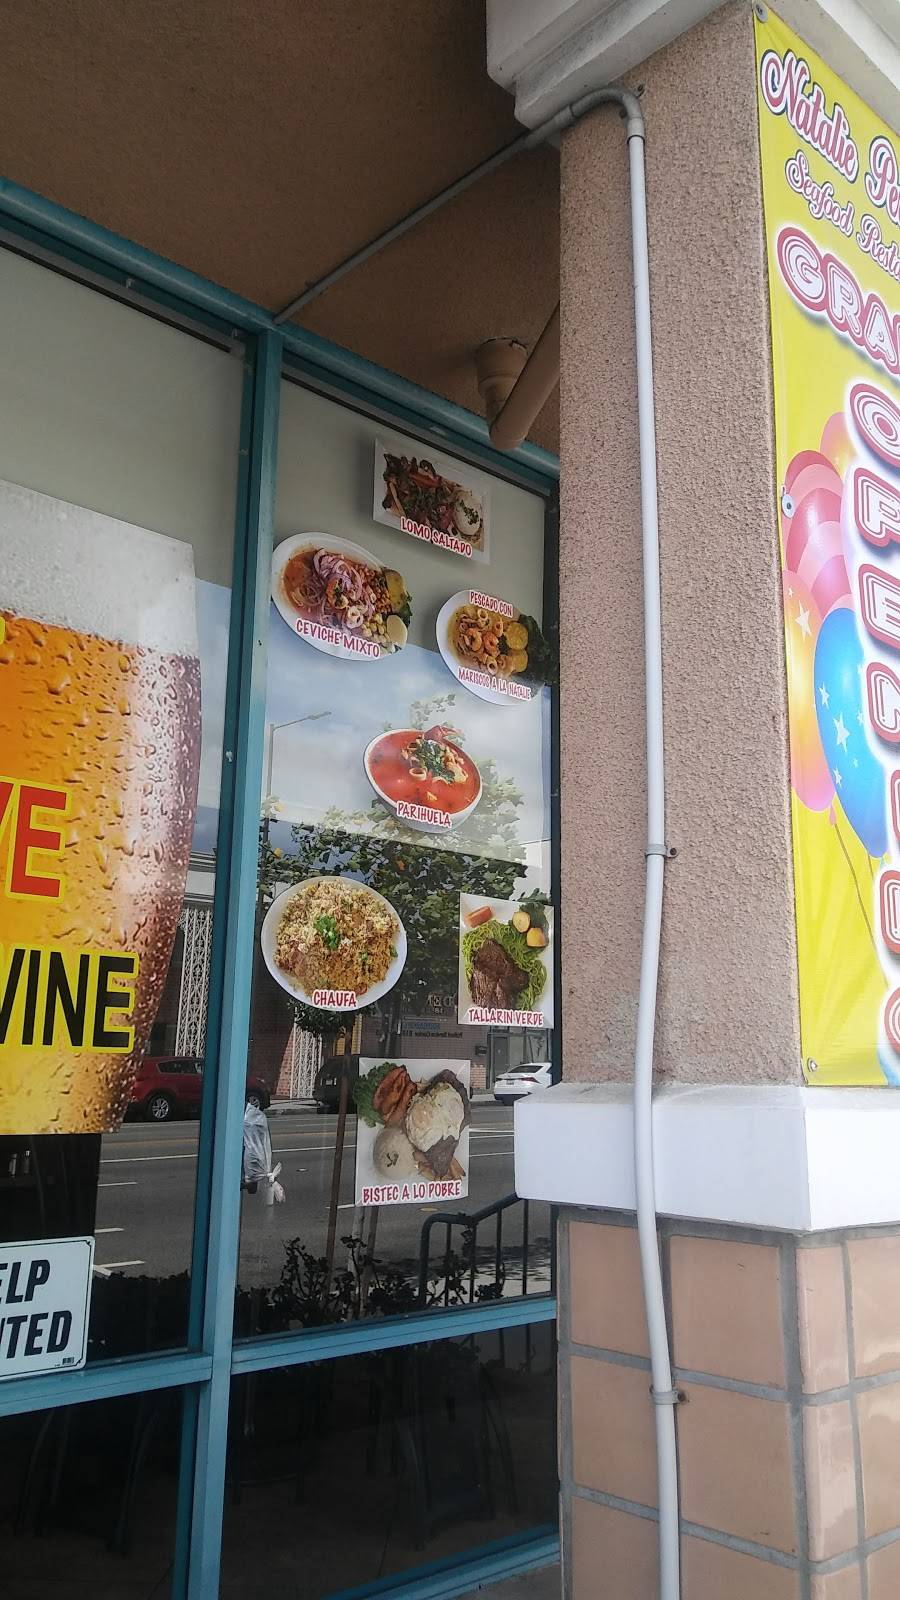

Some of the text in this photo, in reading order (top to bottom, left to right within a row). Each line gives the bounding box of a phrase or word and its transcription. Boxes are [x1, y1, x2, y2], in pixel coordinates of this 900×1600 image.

[762, 50, 900, 225] Natalie Pe
[785, 150, 853, 237] Seafood
[776, 227, 900, 374] GRA
[401, 517, 472, 557] LOMO SALTADO
[470, 591, 513, 617] PESCADO CON
[296, 619, 380, 658] CEVICHE MIXTO
[458, 667, 531, 700] MARISCOS A LA NATALIE
[397, 801, 451, 827] PARIHUELA
[313, 990, 357, 1007] CHAUFA
[468, 1008, 543, 1026] TALLARIN VERDE
[362, 1181, 461, 1203] BISTEC A LO POBRE
[0, 1310, 73, 1359] TED
